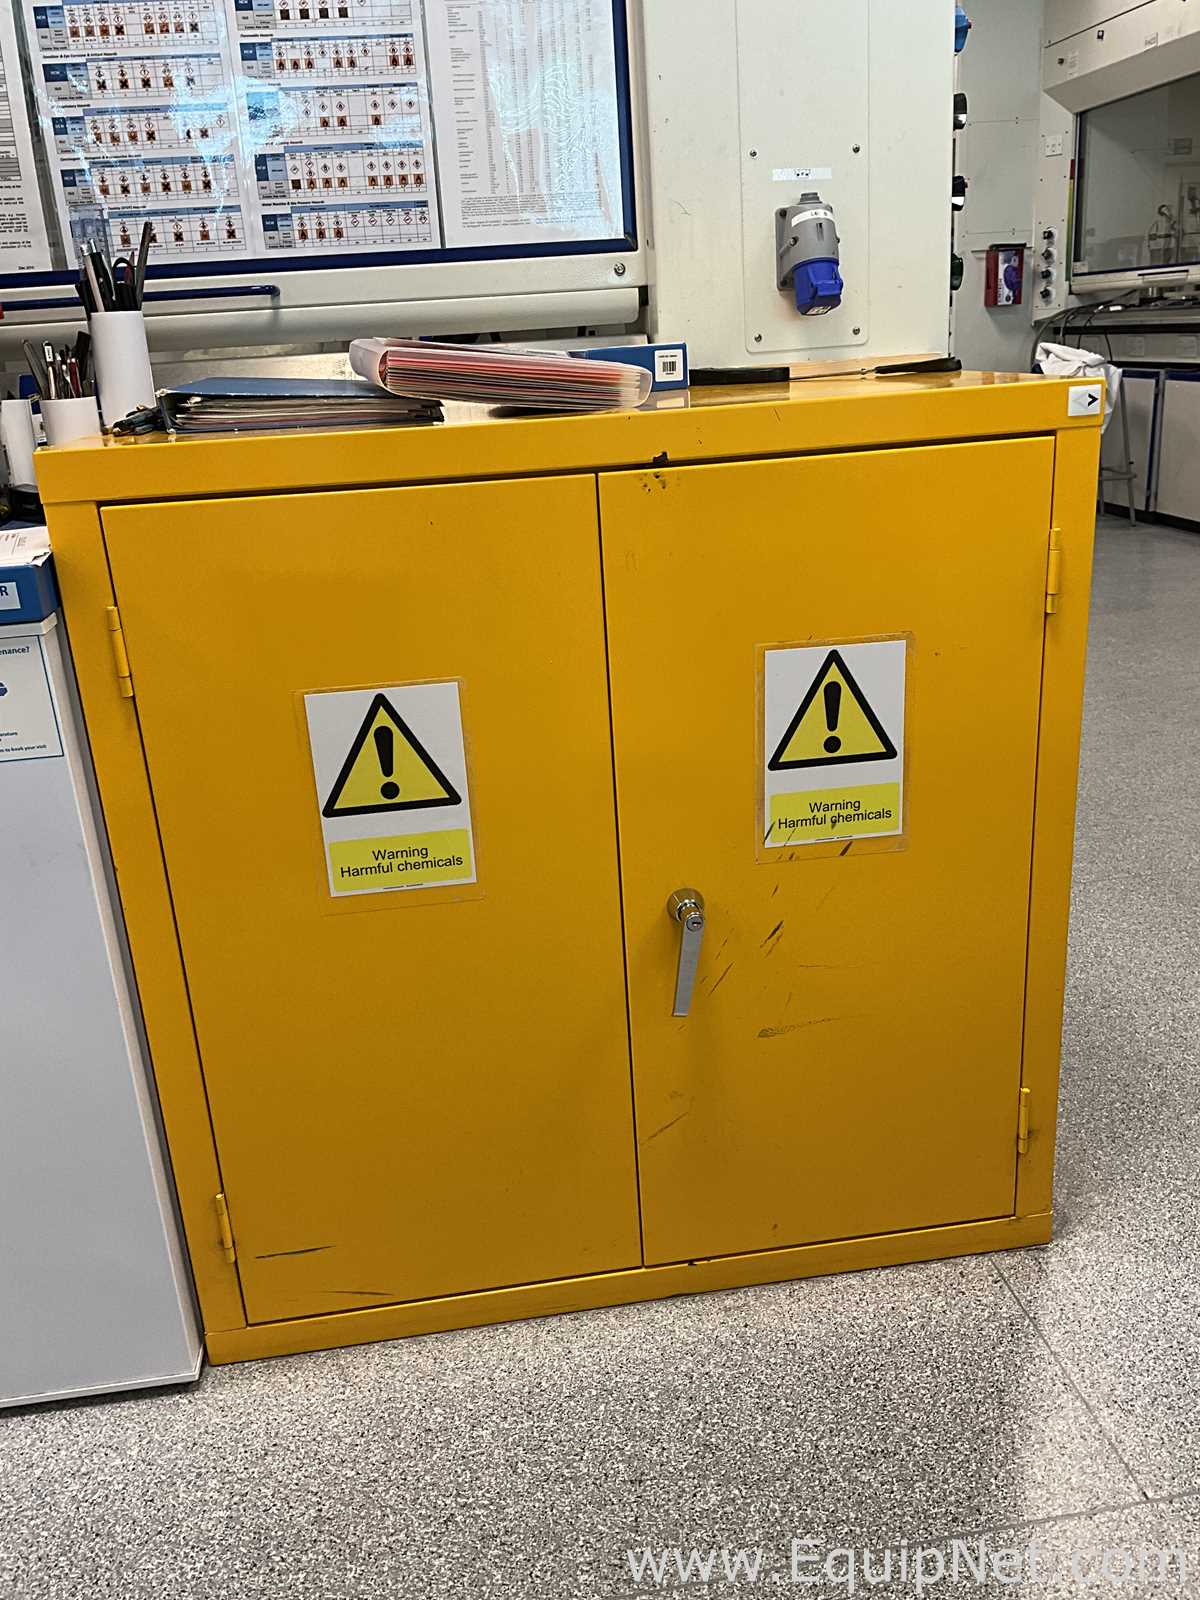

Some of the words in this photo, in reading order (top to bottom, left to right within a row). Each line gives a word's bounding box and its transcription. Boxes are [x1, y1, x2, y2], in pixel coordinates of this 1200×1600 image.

[809, 799, 861, 813] Warning
[778, 814, 827, 829] Harmful
[830, 808, 892, 824] chemicals
[372, 846, 429, 861] Warning
[340, 862, 393, 878] Harmful
[397, 855, 464, 872] chemicals
